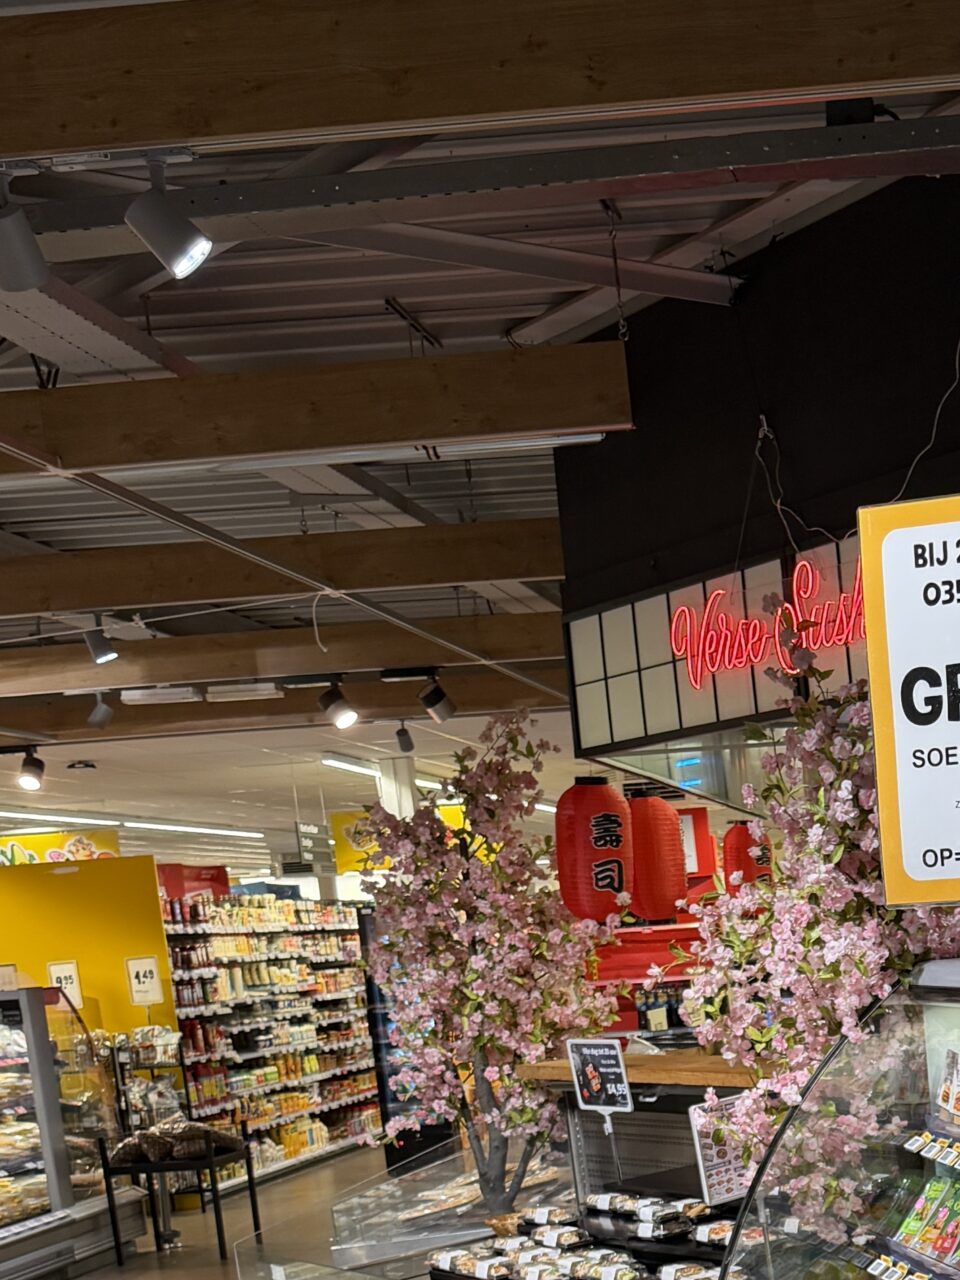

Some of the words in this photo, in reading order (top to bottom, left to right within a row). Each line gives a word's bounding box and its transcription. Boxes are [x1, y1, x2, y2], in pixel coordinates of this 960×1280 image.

[913, 539, 948, 569] BIJ
[670, 589, 774, 691] Verse
[774, 554, 866, 674] Sush
